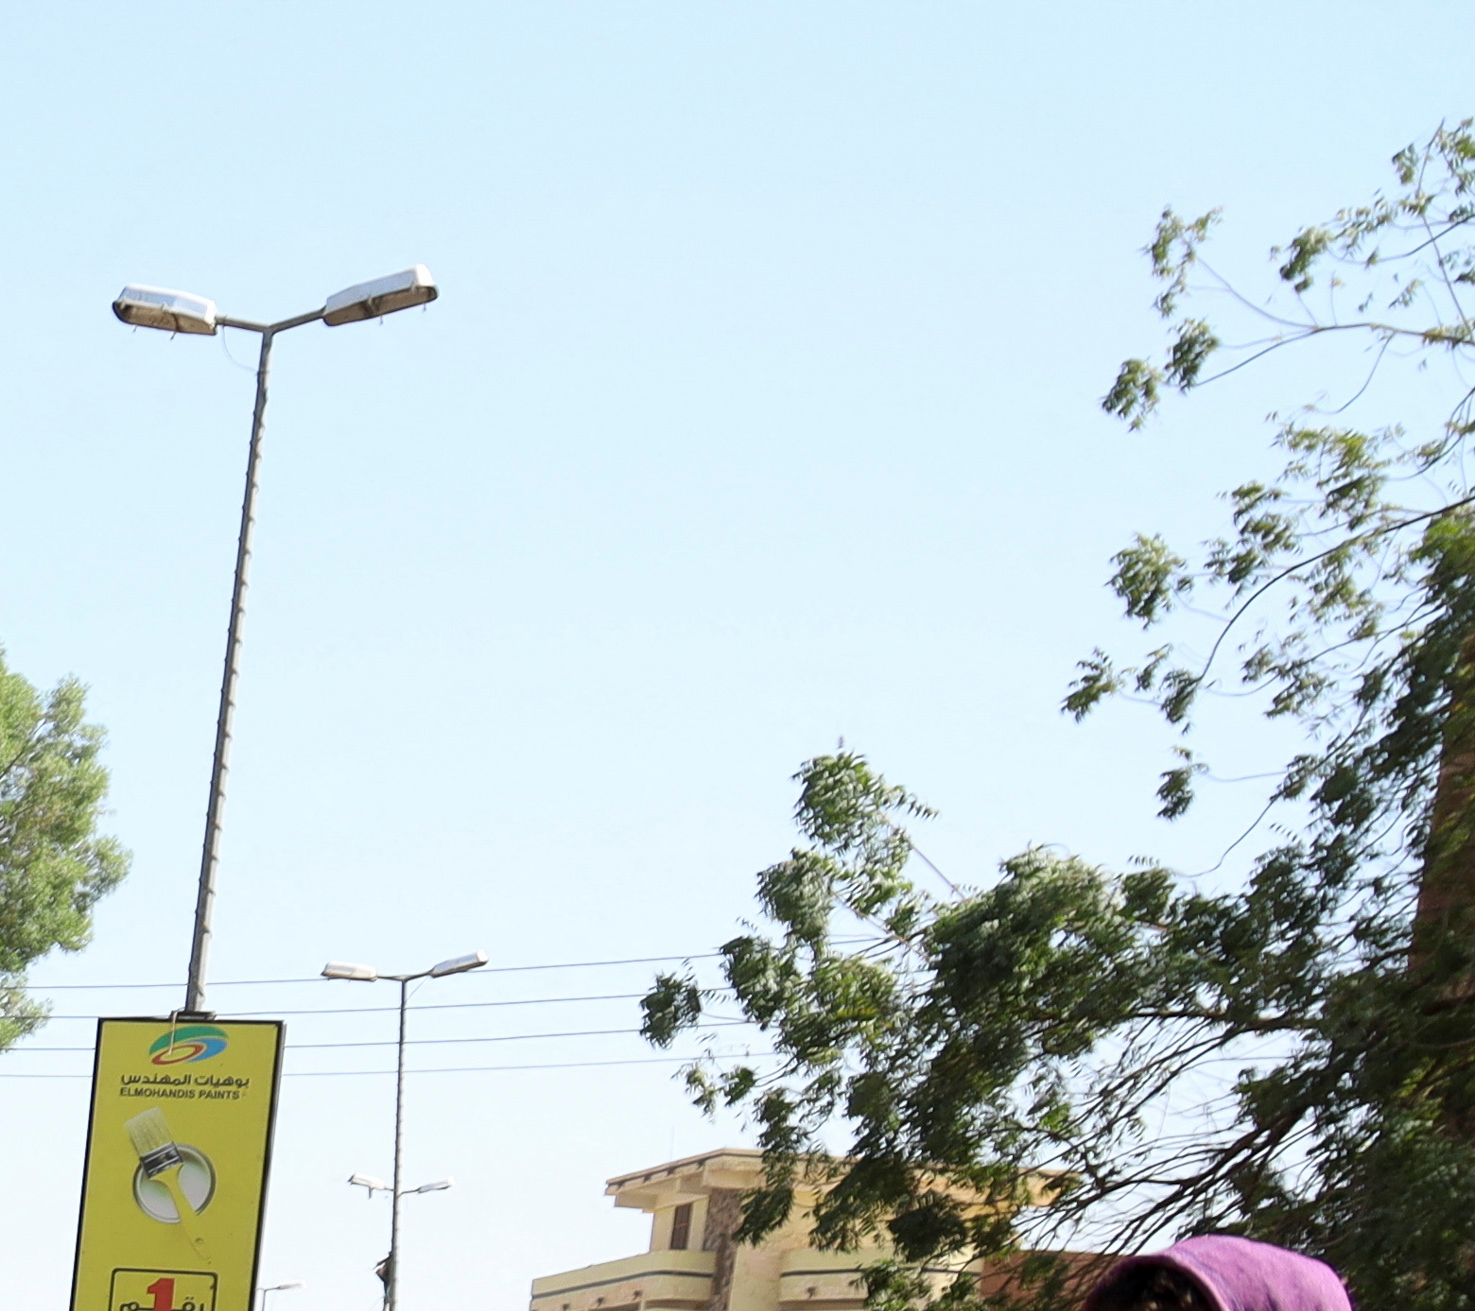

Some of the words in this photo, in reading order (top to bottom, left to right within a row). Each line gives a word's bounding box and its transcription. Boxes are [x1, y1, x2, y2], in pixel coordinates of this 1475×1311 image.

[120, 1073, 192, 1086] المهندس
[194, 1074, 250, 1088] بوهيات
[119, 1087, 196, 1099] ELMOHANDIS
[198, 1090, 241, 1100] PAINTS
